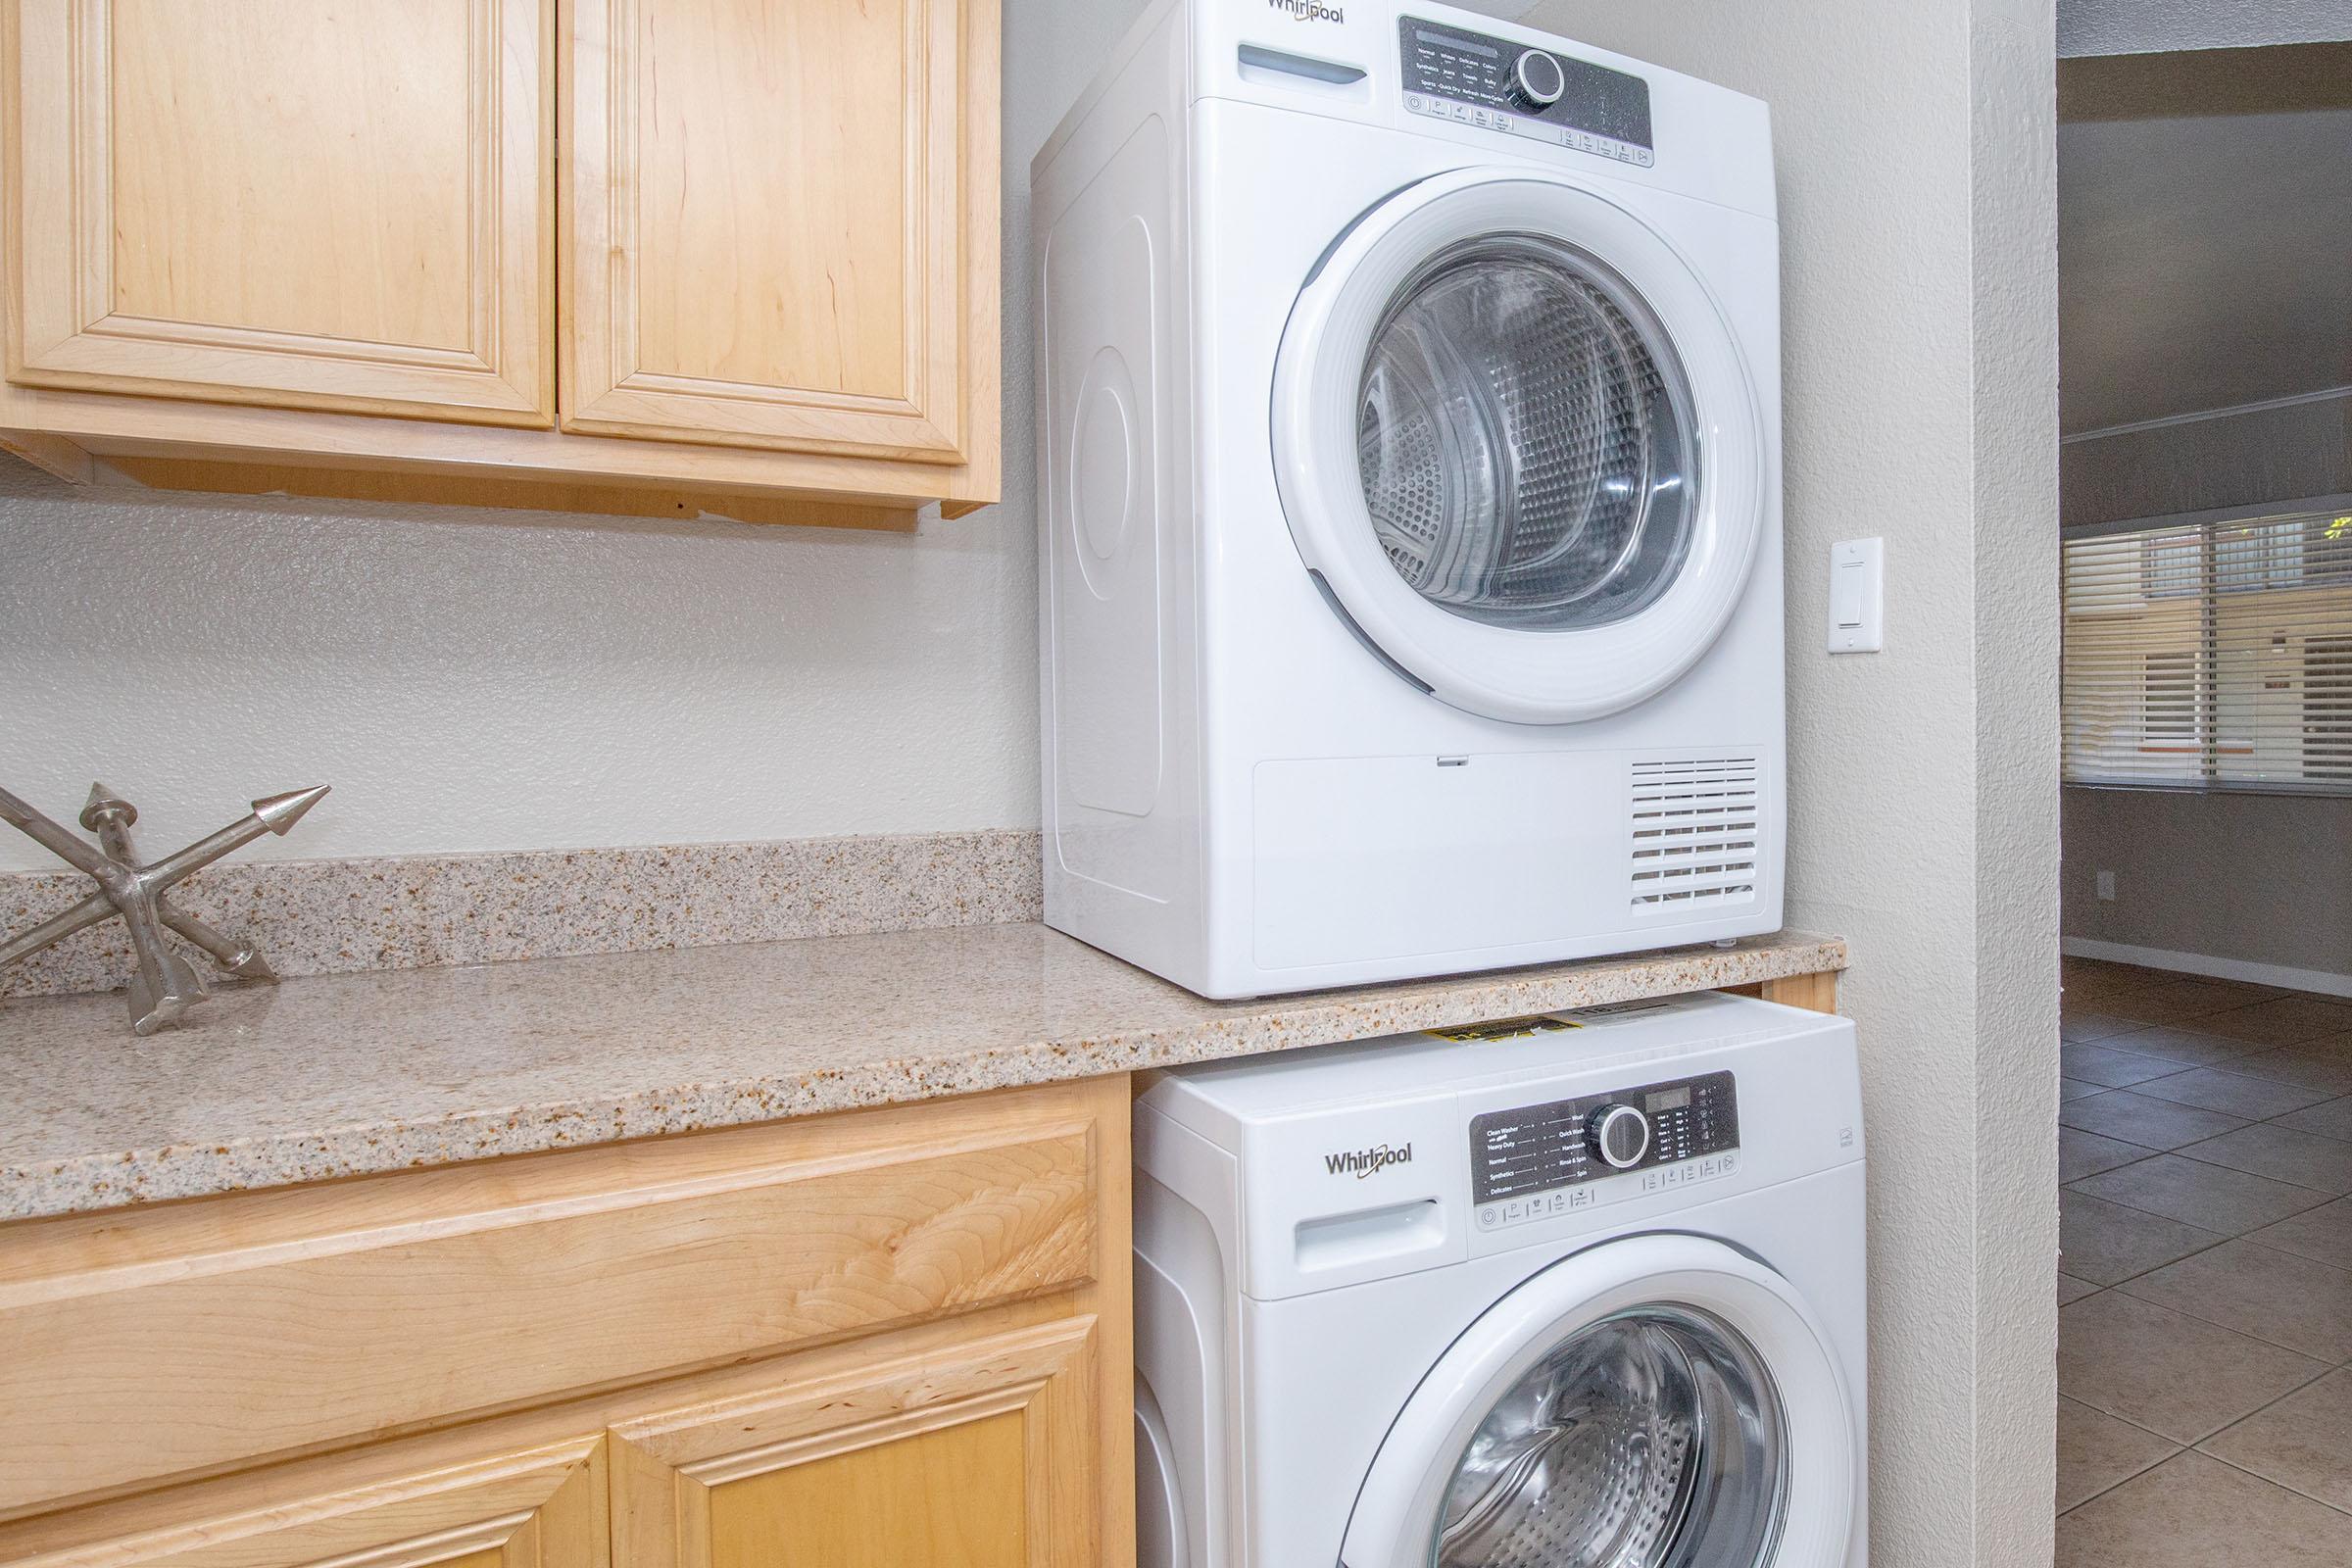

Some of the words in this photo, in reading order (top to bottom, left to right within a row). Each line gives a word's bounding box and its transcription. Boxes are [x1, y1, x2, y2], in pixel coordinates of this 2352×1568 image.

[1562, 1143, 1586, 1152] Handwash
[1325, 1142, 1412, 1174] Whirlpool
[1489, 1157, 1507, 1166] Normal
[1491, 1171, 1515, 1182] Synthetics
[1491, 1187, 1513, 1196] Delicates
